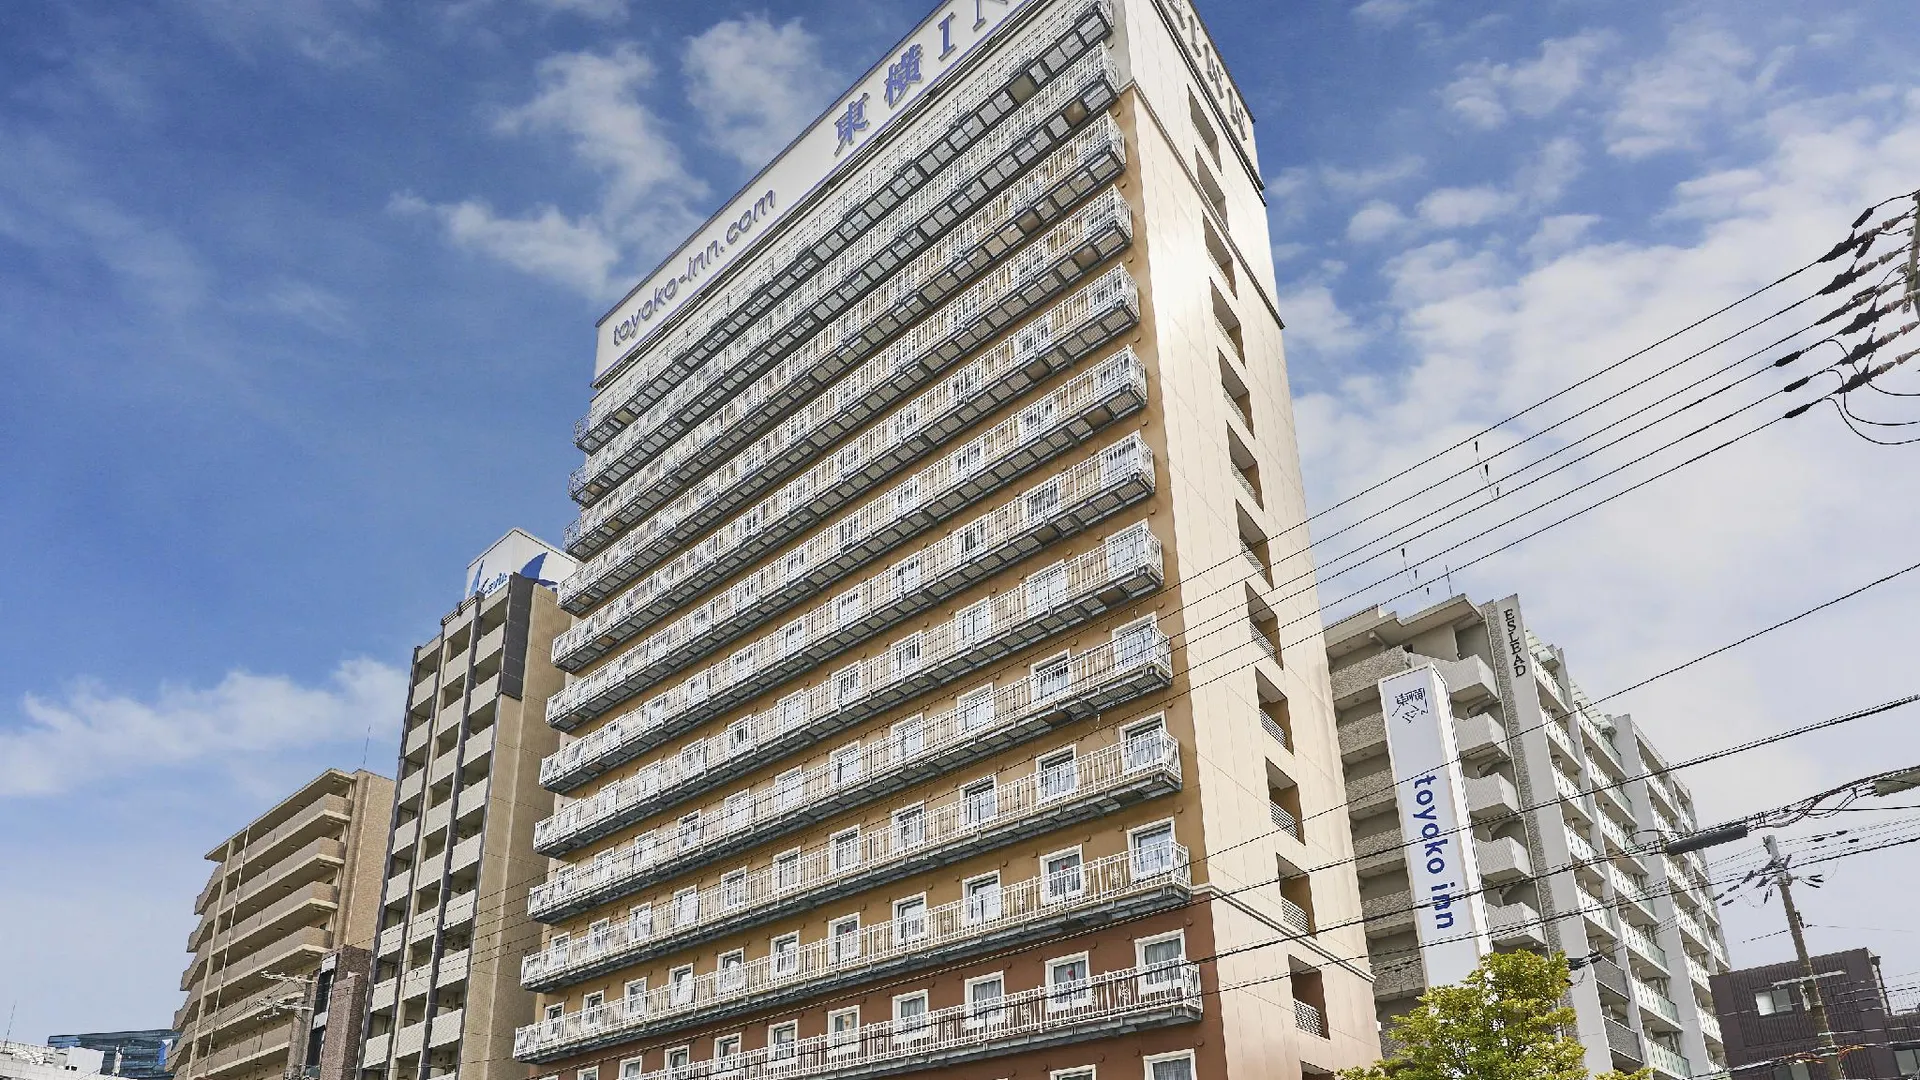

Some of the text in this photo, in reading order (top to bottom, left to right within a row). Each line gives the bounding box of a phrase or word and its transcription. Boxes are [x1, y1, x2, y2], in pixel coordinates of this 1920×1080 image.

[613, 189, 776, 347] toyoko-inn.com
[1503, 608, 1526, 678] ESLEAD
[1413, 774, 1456, 930] toyoko inn
